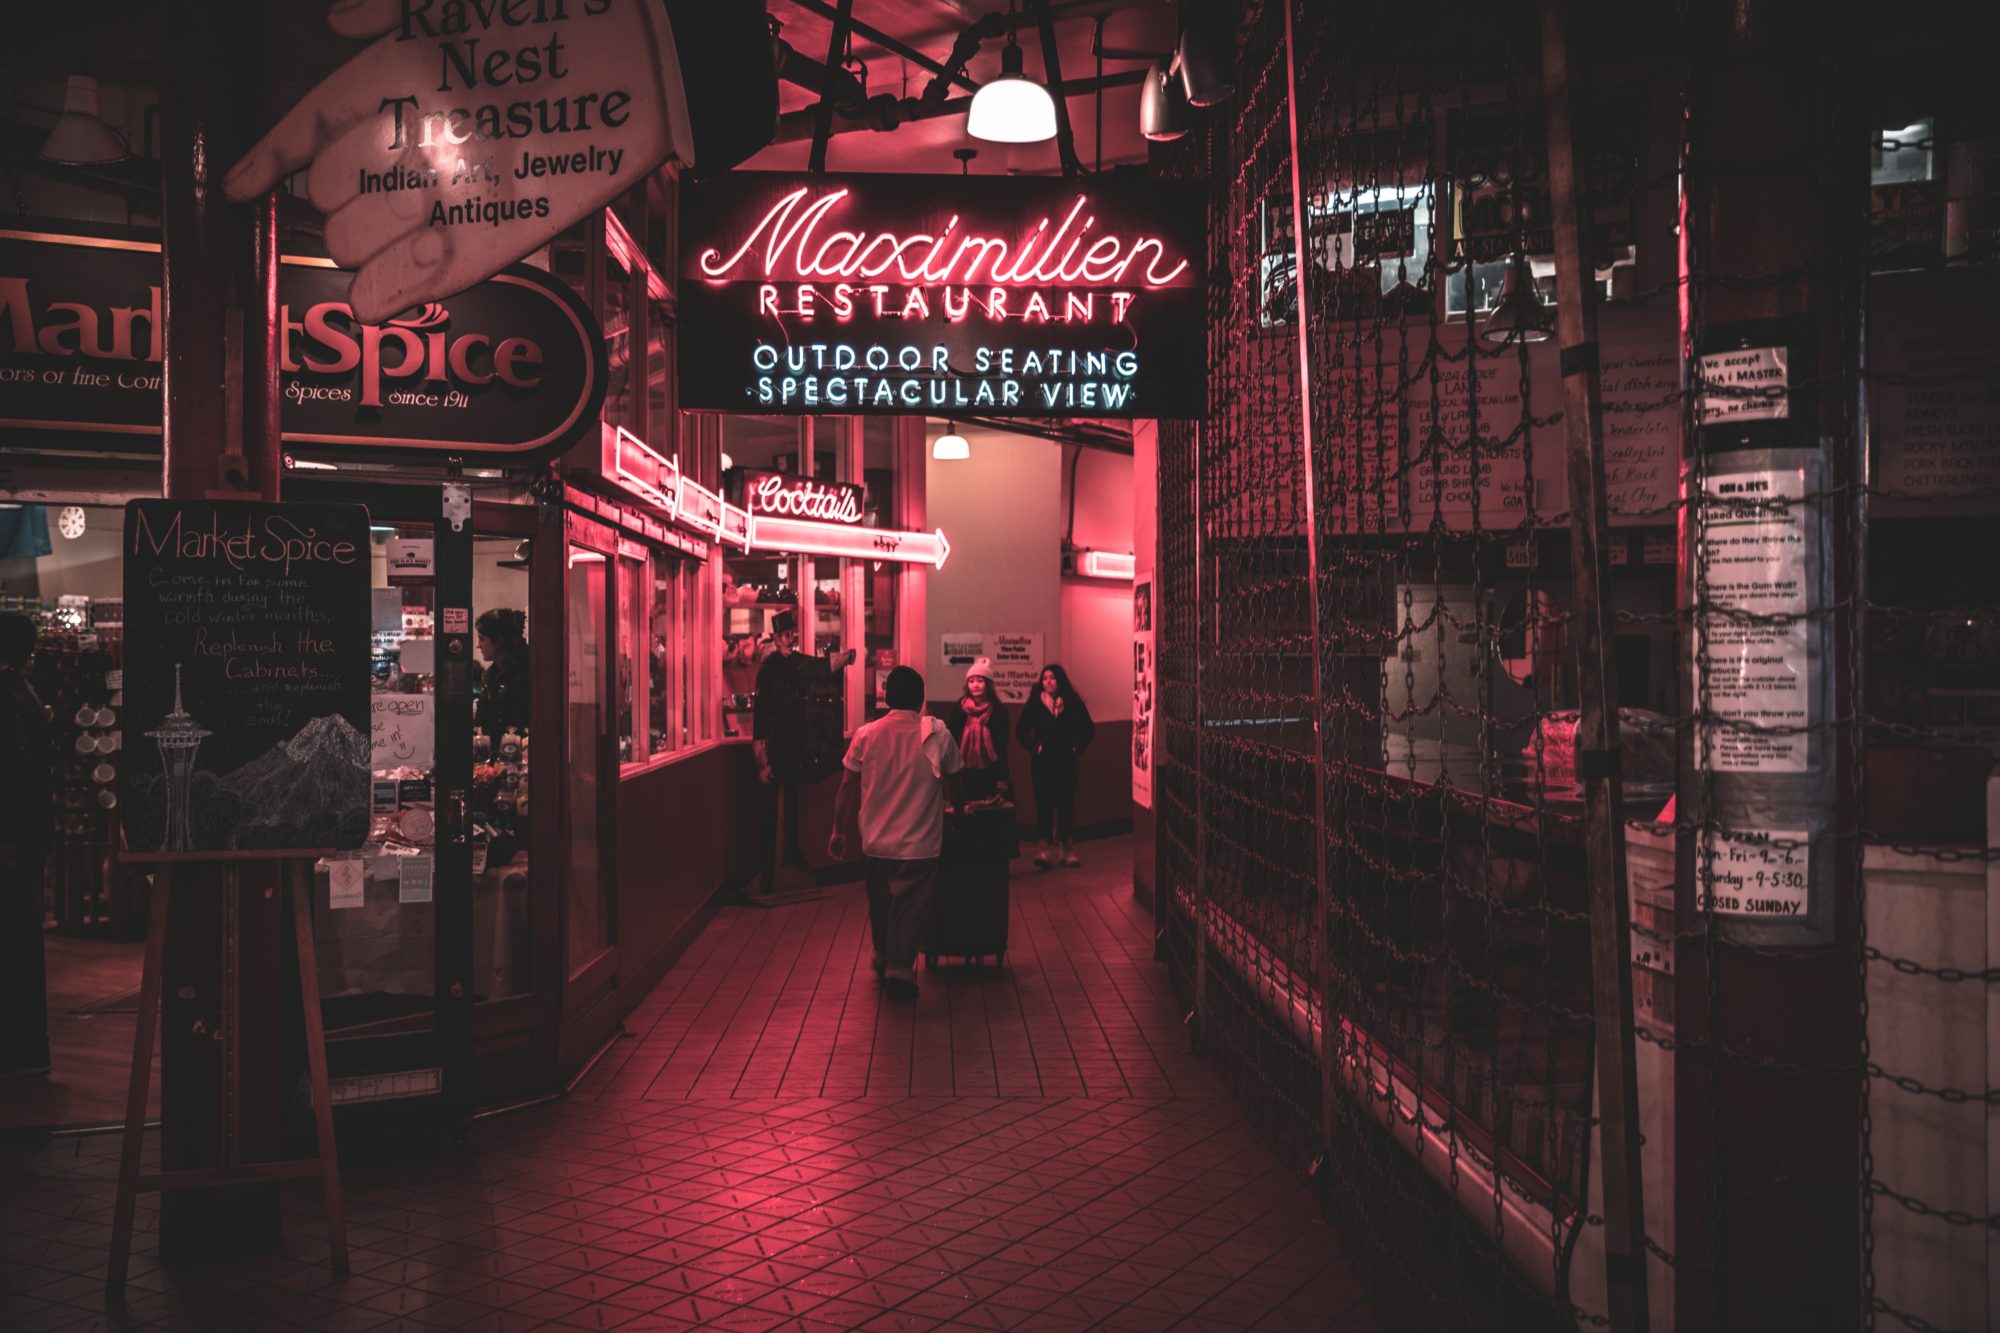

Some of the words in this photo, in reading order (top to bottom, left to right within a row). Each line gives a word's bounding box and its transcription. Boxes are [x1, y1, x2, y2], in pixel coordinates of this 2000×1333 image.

[437, 32, 569, 92] Nest
[378, 90, 632, 150] Treasure
[359, 164, 438, 194] Indian
[514, 145, 624, 180] Jewelry
[429, 196, 549, 227] Antiques
[700, 186, 1191, 285] Maximilien
[760, 284, 1133, 323] RESTAURANT
[753, 344, 949, 371] OUTDOOR
[975, 347, 1138, 376] SEATING
[1724, 353, 1760, 367] accept
[1702, 373, 1725, 384] ISA
[285, 381, 351, 405] Spices
[388, 390, 439, 407] Since
[758, 377, 1019, 405] SPECTACULAR
[1043, 382, 1130, 408] VIEW
[1702, 406, 1724, 418] orry,
[1419, 465, 1460, 477] GRUND
[1451, 477, 1491, 489] SHAKS
[758, 476, 862, 523] Cocktails
[215, 573, 231, 585] in
[164, 608, 201, 624] cold
[296, 627, 336, 654] the
[388, 699, 424, 715] open
[1697, 894, 1739, 910] COSED
[1745, 898, 1801, 914] SUNDAY
